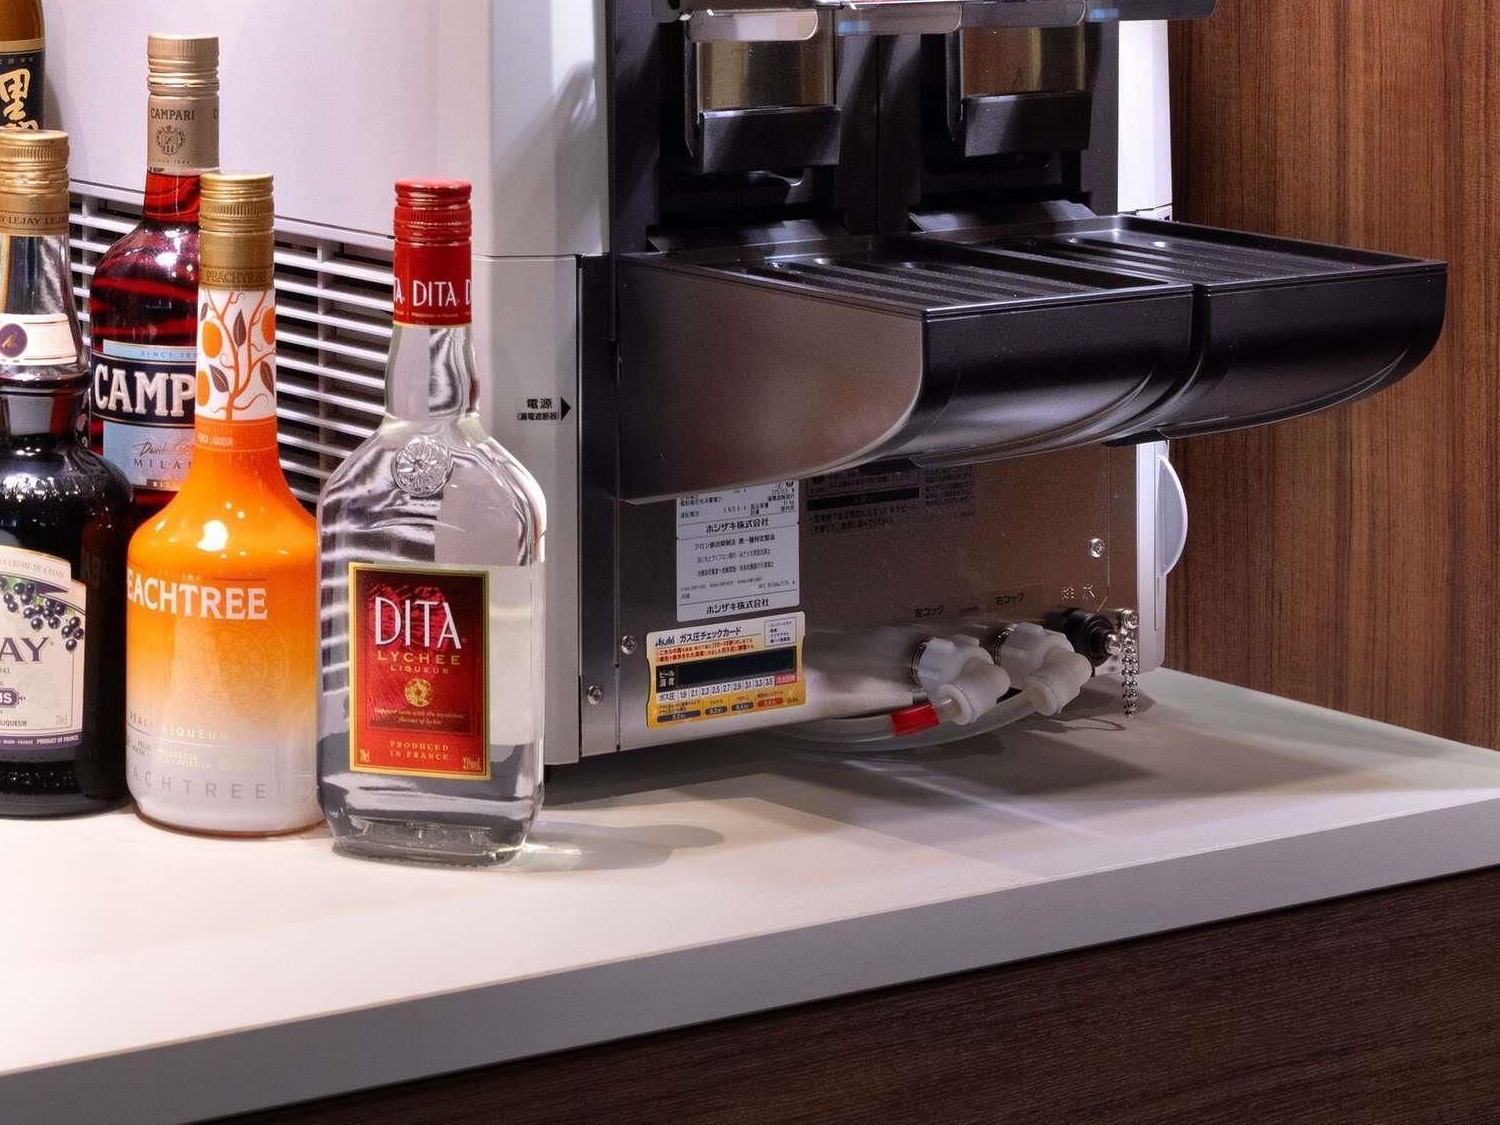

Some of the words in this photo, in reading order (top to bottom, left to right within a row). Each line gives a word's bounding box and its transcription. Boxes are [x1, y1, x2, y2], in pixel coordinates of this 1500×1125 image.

[150, 109, 196, 122] CAMPARI
[412, 279, 457, 307] DITA
[140, 350, 173, 359] SINCE
[94, 363, 196, 418] CAMP
[527, 398, 553, 409] 電源
[133, 457, 191, 470] MILA
[706, 518, 769, 534] ホシザキ株式会社
[127, 569, 269, 620] EACHTREE
[706, 598, 769, 614] ホシザキ株式会社
[374, 596, 462, 650] DITA
[679, 626, 742, 644] ガス圧チェックカード
[377, 650, 461, 665] LYCHEE
[390, 665, 450, 675] LIQUEUR
[659, 691, 675, 702] ガス圧
[690, 689, 698, 697] 2.1
[712, 686, 720, 694] 2.5
[722, 684, 731, 693] 2.7
[733, 682, 741, 691] 2.9
[755, 679, 763, 687] 3.3
[765, 678, 773, 686] 3.5
[0, 718, 28, 727] LIQUEUR
[389, 740, 449, 752] PRODUCED
[389, 750, 402, 758] IN
[406, 751, 449, 761] FRANCE
[131, 765, 269, 800] ACHTREE
